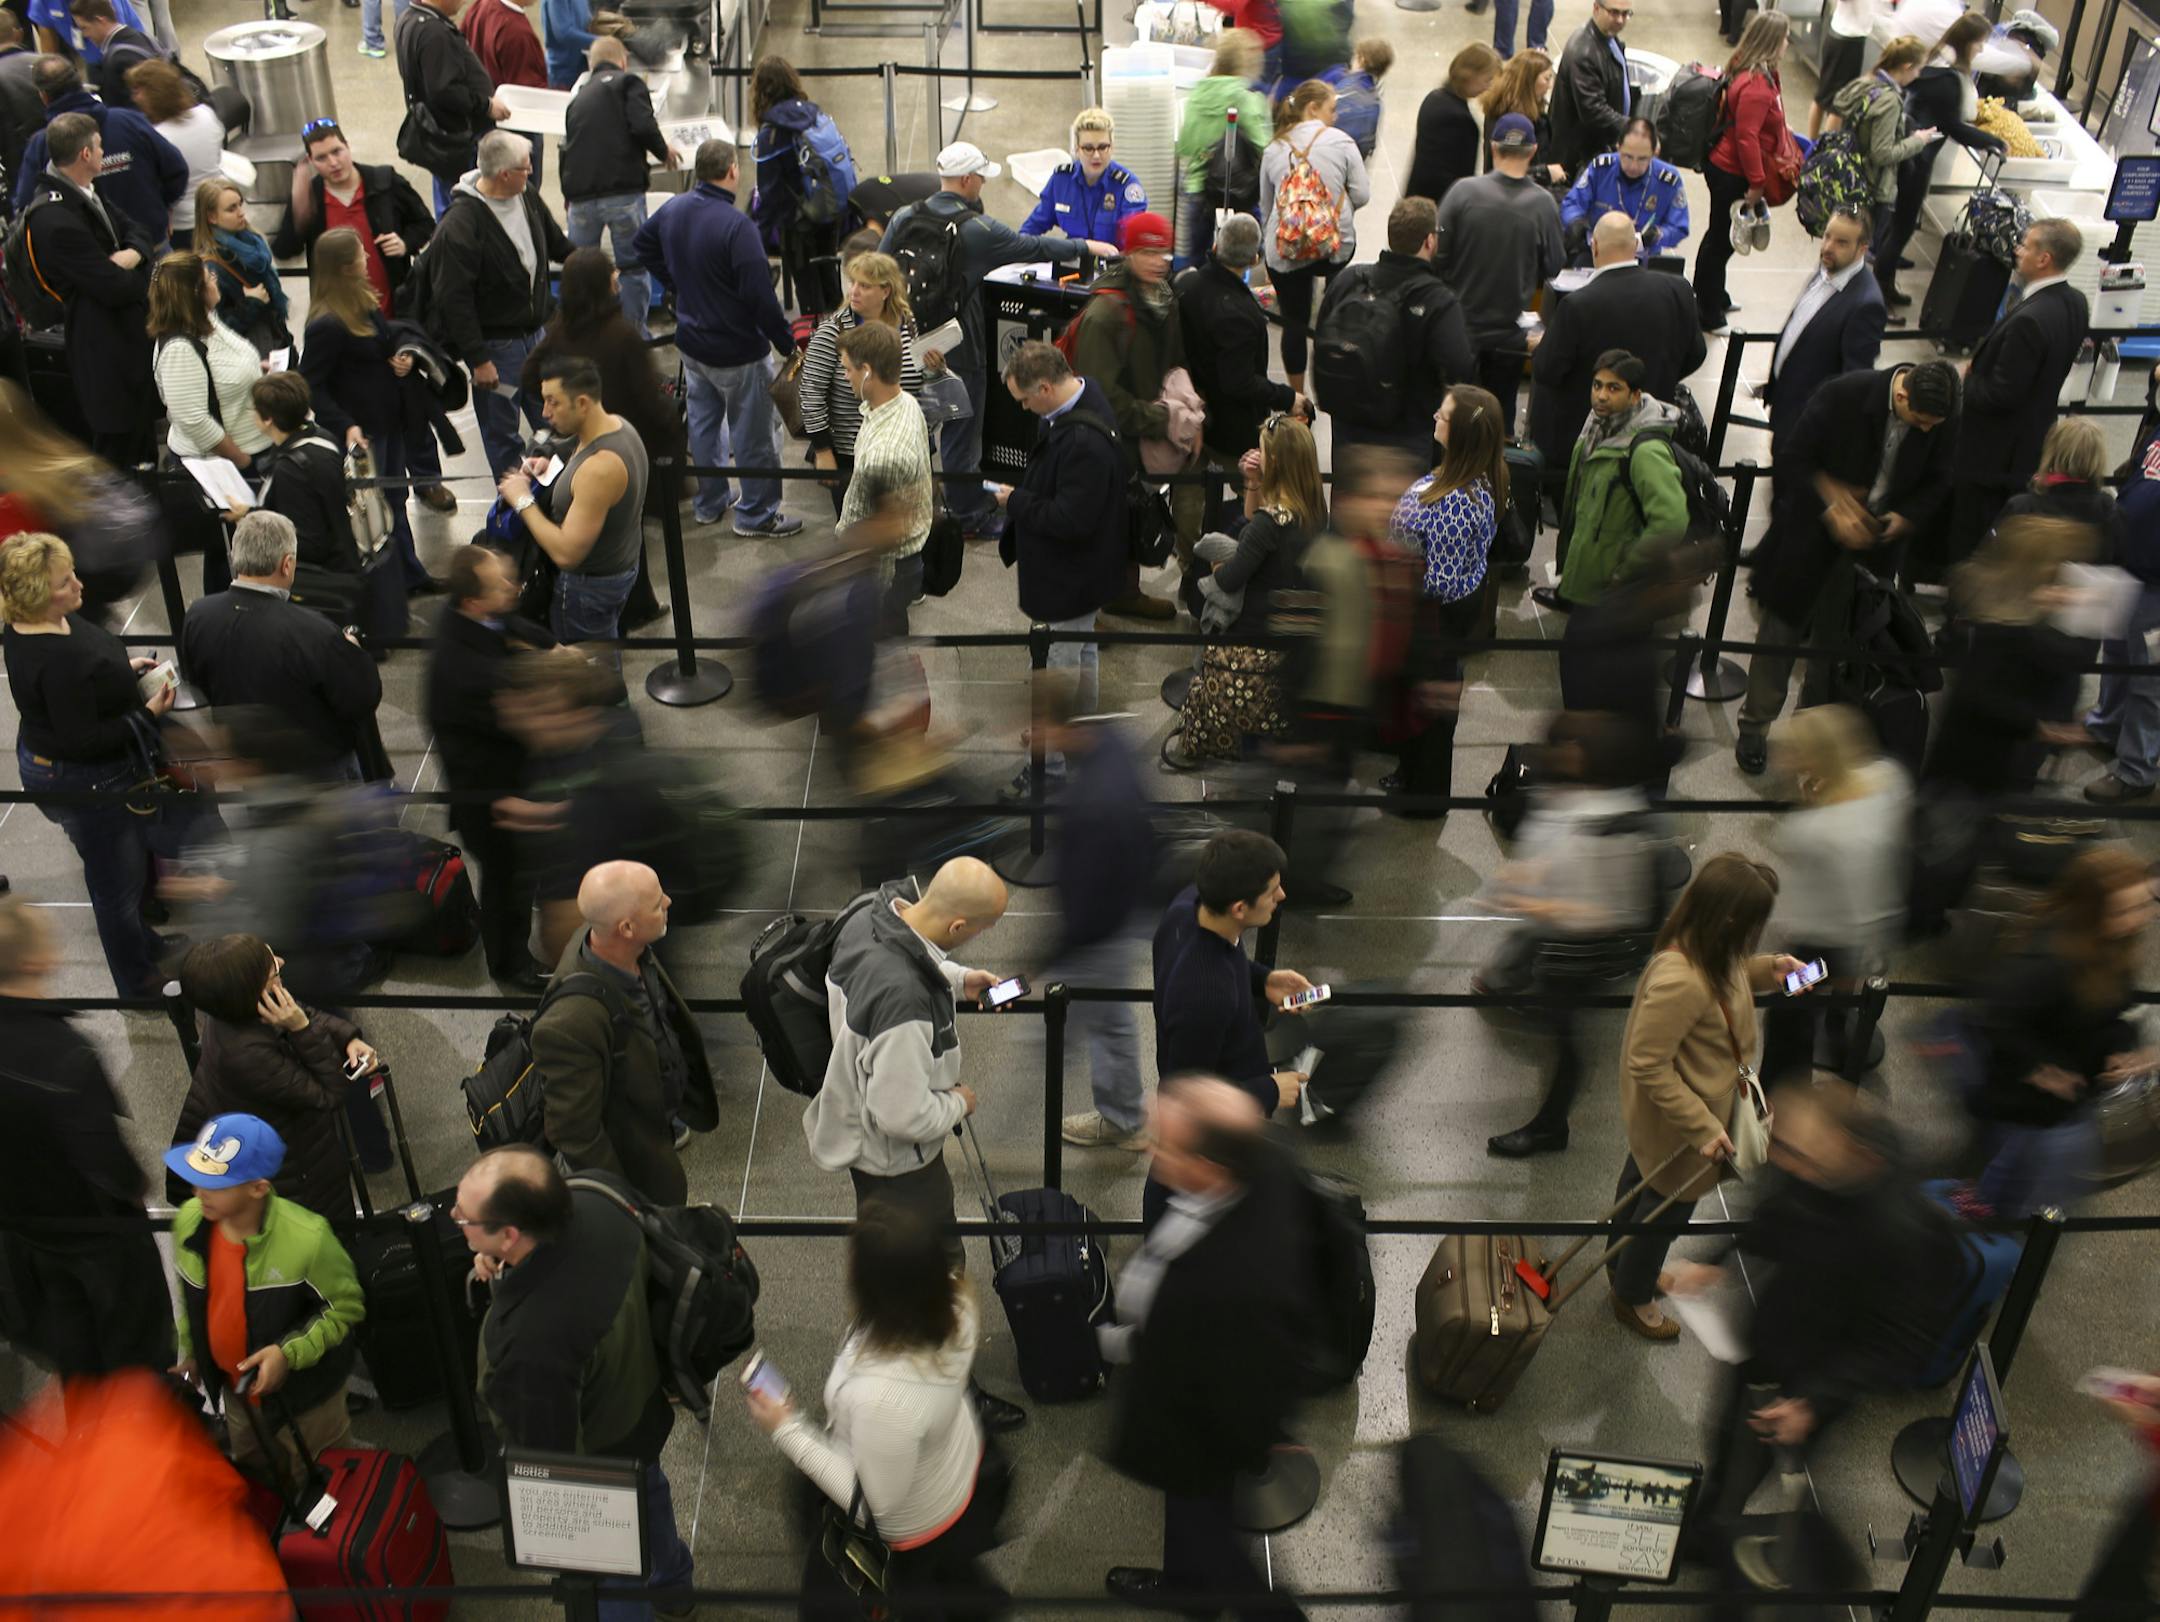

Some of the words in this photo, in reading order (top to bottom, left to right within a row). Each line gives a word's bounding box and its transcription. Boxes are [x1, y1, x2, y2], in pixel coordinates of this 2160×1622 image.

[514, 1464, 550, 1478] Notice
[1624, 1529, 1672, 1549] SEE
[1619, 1551, 1668, 1569] SAY
